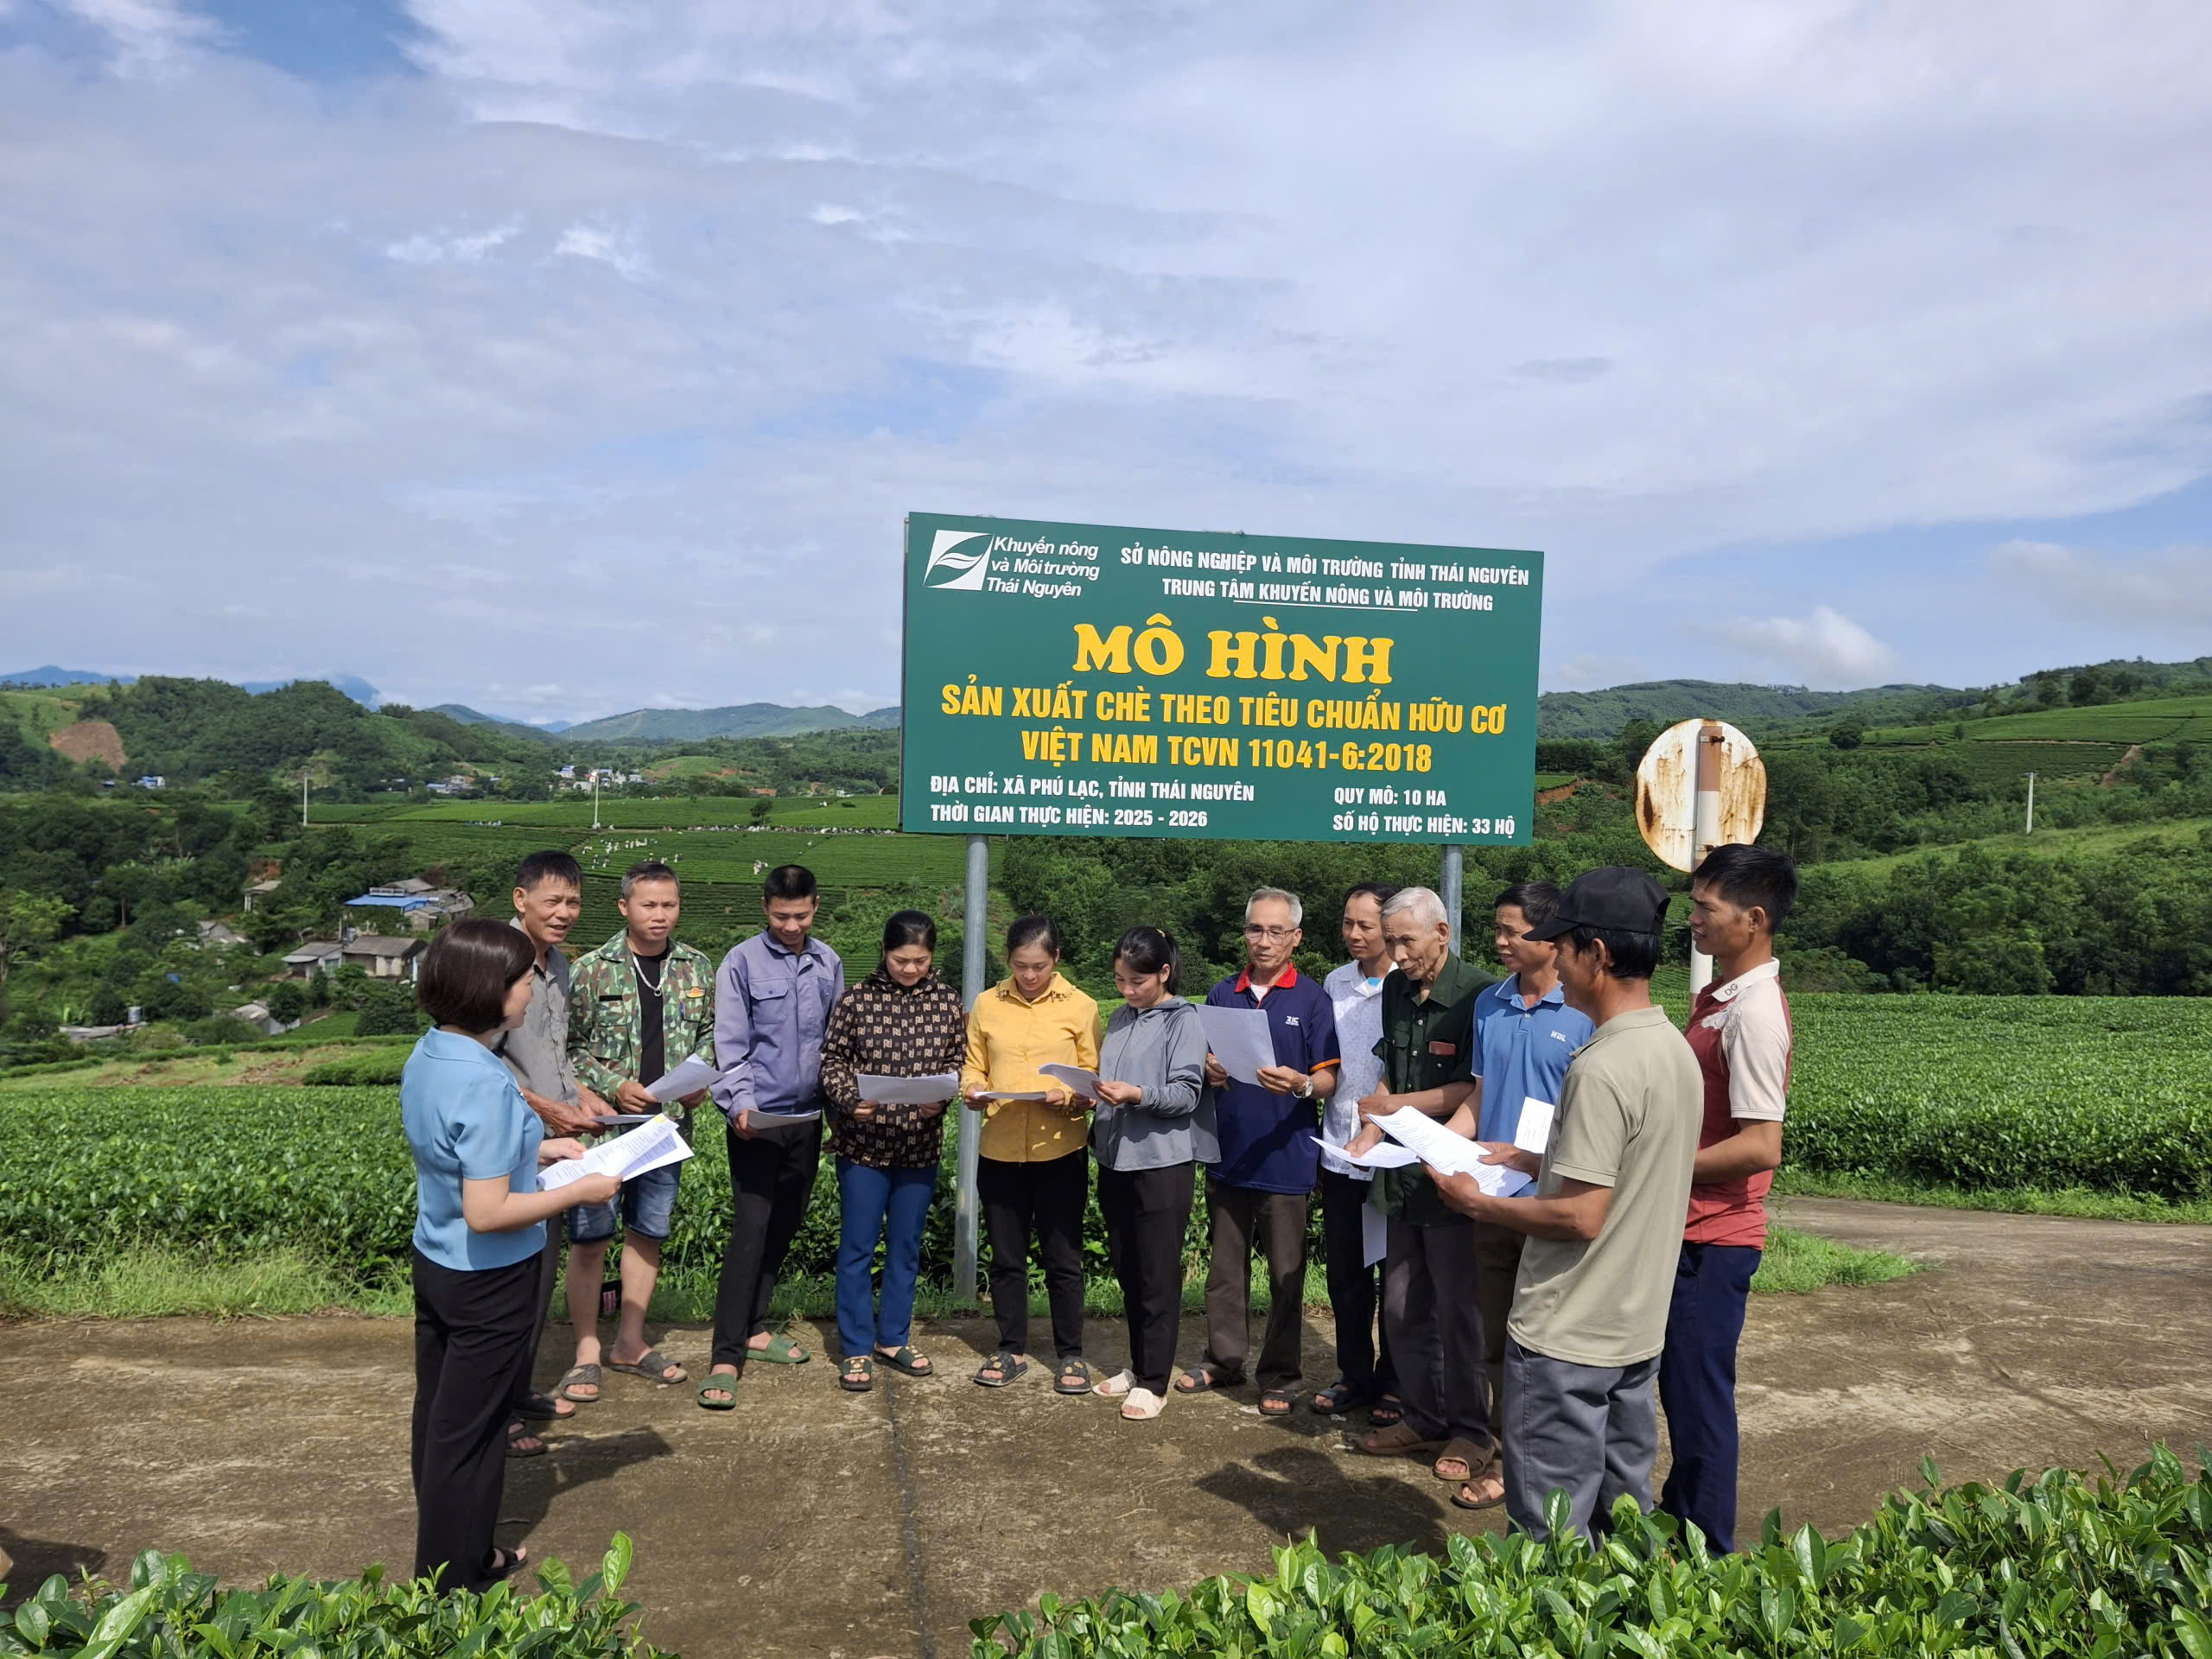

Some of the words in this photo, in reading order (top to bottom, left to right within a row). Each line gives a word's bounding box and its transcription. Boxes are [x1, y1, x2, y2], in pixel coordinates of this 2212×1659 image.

[994, 536, 1054, 556] Khuyến
[1058, 541, 1099, 561] nông
[991, 557, 1009, 572] và
[1014, 558, 1042, 574] Môi
[1044, 563, 1100, 582] trường
[1120, 542, 1144, 564] SỞ
[1147, 545, 1193, 569] NÔNG
[1198, 550, 1257, 575] NGHIỆP
[1262, 552, 1282, 573] VÀ
[1287, 554, 1317, 575] MÔI
[1322, 556, 1383, 578] TRƯỜNG
[1390, 556, 1426, 581] TỈNH
[1429, 563, 1464, 582] THÁI
[1468, 565, 1529, 586] NGUYÊN
[987, 576, 1019, 594] Thái
[1022, 580, 1082, 599] Nguyên
[1162, 578, 1216, 597] TRUNG
[1220, 578, 1254, 599] TÂM
[1259, 581, 1321, 603] KHUYẾN
[1325, 583, 1370, 605] NÔNG
[1375, 586, 1395, 607] VÀ
[1399, 588, 1428, 608] MÔI
[1433, 589, 1493, 611] TRƯỜNG
[1072, 612, 1185, 676] MÔ
[1205, 615, 1395, 684] HÌNH
[941, 673, 1003, 717] SẢN
[1011, 680, 1088, 720] XUẤT
[1096, 685, 1151, 722] CHÈ
[1160, 693, 1230, 725] THEO
[1239, 690, 1299, 728] TIÊU
[1306, 688, 1402, 731] CHUẨN
[1408, 696, 1463, 734] HỮU
[1471, 703, 1507, 734] CƠ
[1021, 725, 1084, 767] VIỆT
[1091, 733, 1158, 764] NAM
[1167, 735, 1239, 767] TCVN
[1249, 738, 1433, 772] 11041-6:2018
[931, 775, 960, 797] ĐỊA
[964, 771, 998, 794] CHỈ:
[1002, 774, 1026, 795] XÃ
[1030, 775, 1064, 796] PHÚ
[1068, 779, 1103, 800] LẠC,
[1109, 775, 1146, 798] TỈNH
[1150, 779, 1186, 799] THÁI
[1191, 780, 1255, 802] NGUYÊN
[1334, 787, 1365, 805] QUY
[1369, 785, 1398, 805] MÔ:
[1403, 789, 1421, 806] 10
[1426, 790, 1446, 806] HA
[931, 800, 969, 822] THỜI
[974, 805, 1014, 823] GIAN
[1019, 805, 1061, 828] THỰC
[1065, 804, 1109, 829] HIỆN:
[1114, 808, 1154, 826] 2025
[1168, 810, 1208, 827] 2026
[1332, 810, 1356, 831] SỐ
[1357, 811, 1380, 836] HỘ
[1383, 814, 1423, 836] THỰC
[1427, 813, 1468, 837] HIỆN:
[1471, 817, 1491, 835] 33
[1495, 815, 1516, 839] HỘ
[1724, 983, 1738, 995] DG
